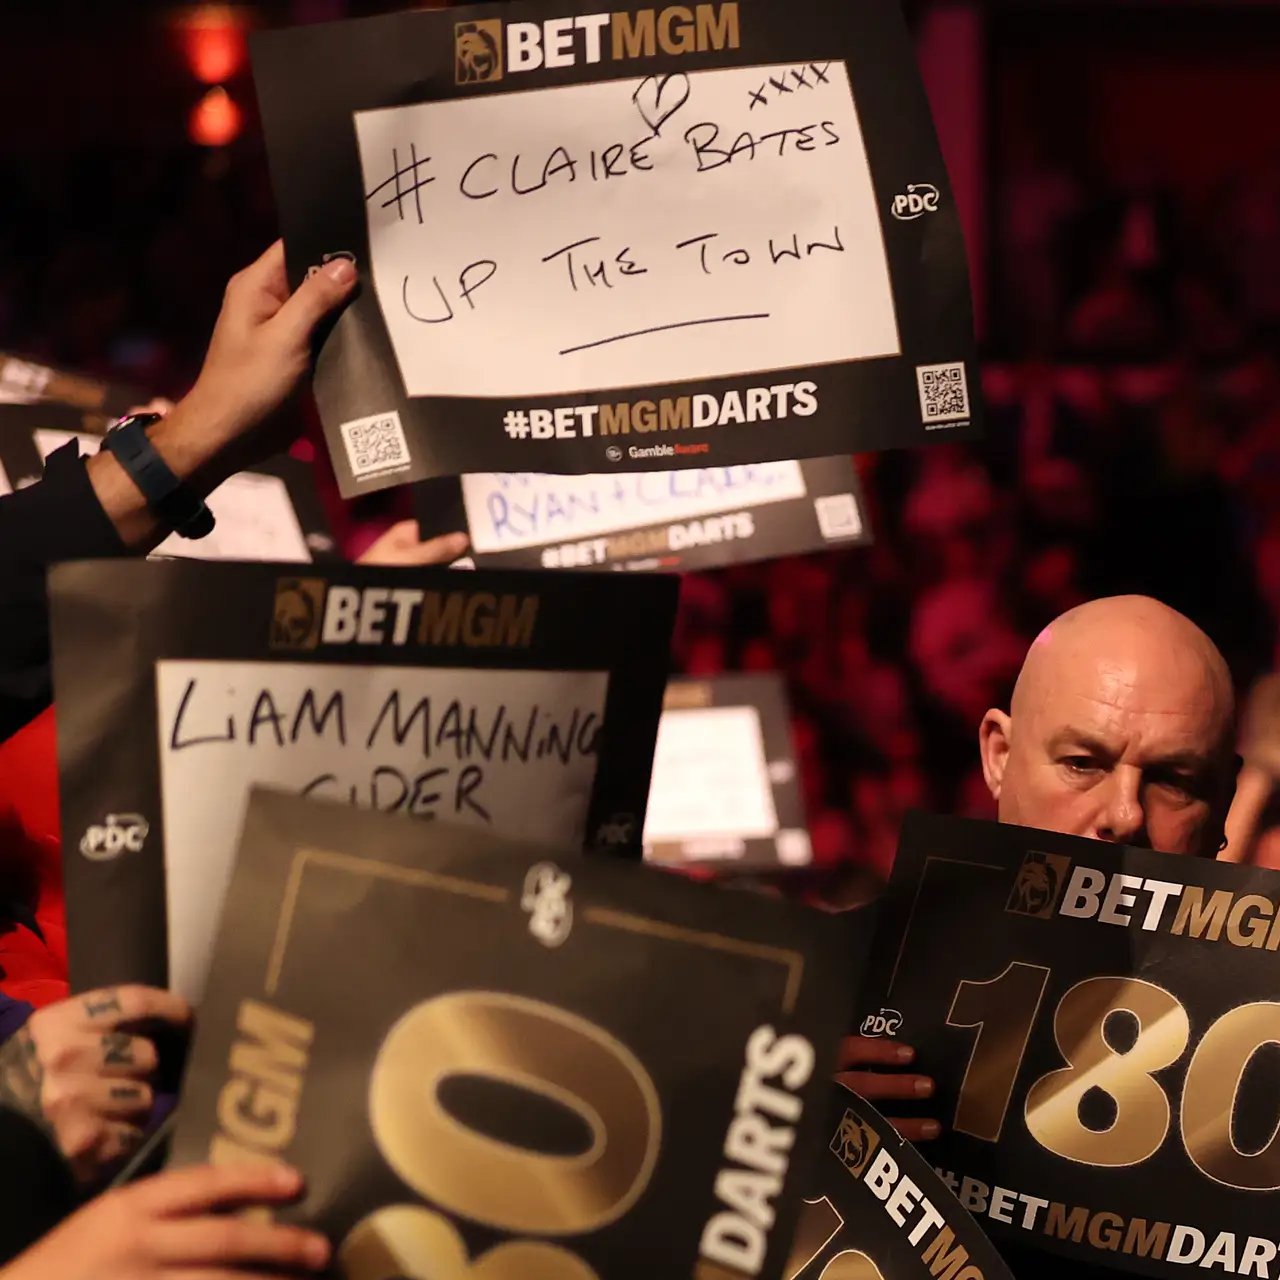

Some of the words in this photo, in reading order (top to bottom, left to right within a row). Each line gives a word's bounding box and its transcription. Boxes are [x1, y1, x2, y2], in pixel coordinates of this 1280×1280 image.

[507, 2, 740, 74] BETMGM
[685, 121, 840, 171] BATES
[892, 188, 939, 217] PDC
[402, 260, 497, 324] UP
[503, 381, 818, 440] #BETMGMDARTS
[321, 586, 540, 648] BETMGM
[861, 1009, 903, 1038] PDC
